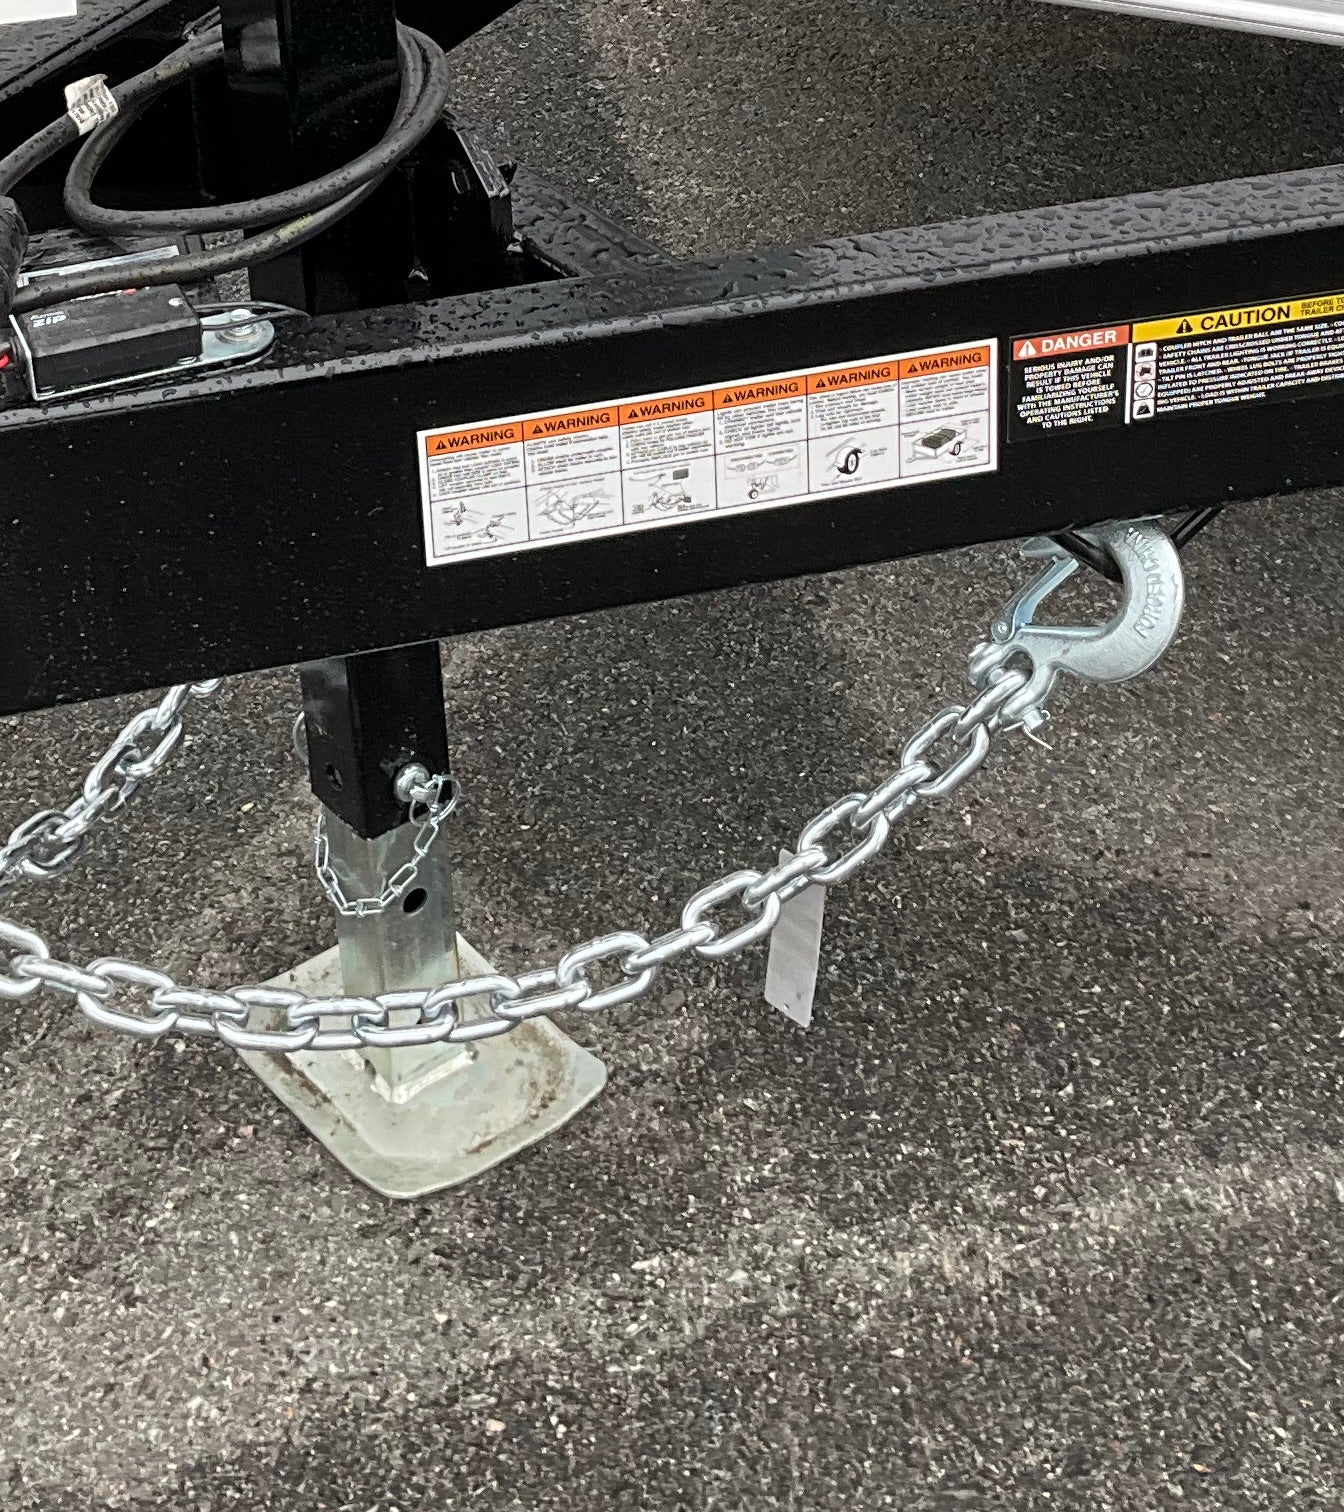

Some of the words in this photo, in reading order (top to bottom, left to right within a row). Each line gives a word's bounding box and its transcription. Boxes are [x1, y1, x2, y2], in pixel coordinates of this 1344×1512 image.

[1301, 298, 1333, 308] BEFORE
[1301, 305, 1333, 315] TRAILER
[1201, 305, 1290, 330] CAUTION
[1041, 330, 1117, 353] DANGER
[919, 352, 982, 371] WARNING
[827, 367, 891, 386] WARNING
[1024, 369, 1062, 380] PROPERTY
[1063, 364, 1095, 375] DAMAGE
[1097, 362, 1113, 371] CAN
[1026, 377, 1052, 387] RESULT
[1062, 374, 1079, 382] THIS
[1081, 369, 1111, 380] VEHICLE
[734, 382, 799, 402] WARNING
[1045, 382, 1071, 392] TOWED
[1072, 378, 1100, 388] BEFORE
[1077, 383, 1114, 395] YOURSELF
[639, 397, 705, 416] WARNING
[1016, 401, 1036, 410] WITH
[1038, 399, 1051, 407] THE
[1019, 405, 1061, 417] OPERATING
[1062, 397, 1115, 411] INSTRUCTIONS
[543, 412, 610, 432] WARNING
[1027, 414, 1043, 423] AND
[1083, 406, 1108, 416] LISTED
[1053, 418, 1067, 427] THE
[448, 428, 515, 448] WARNING
